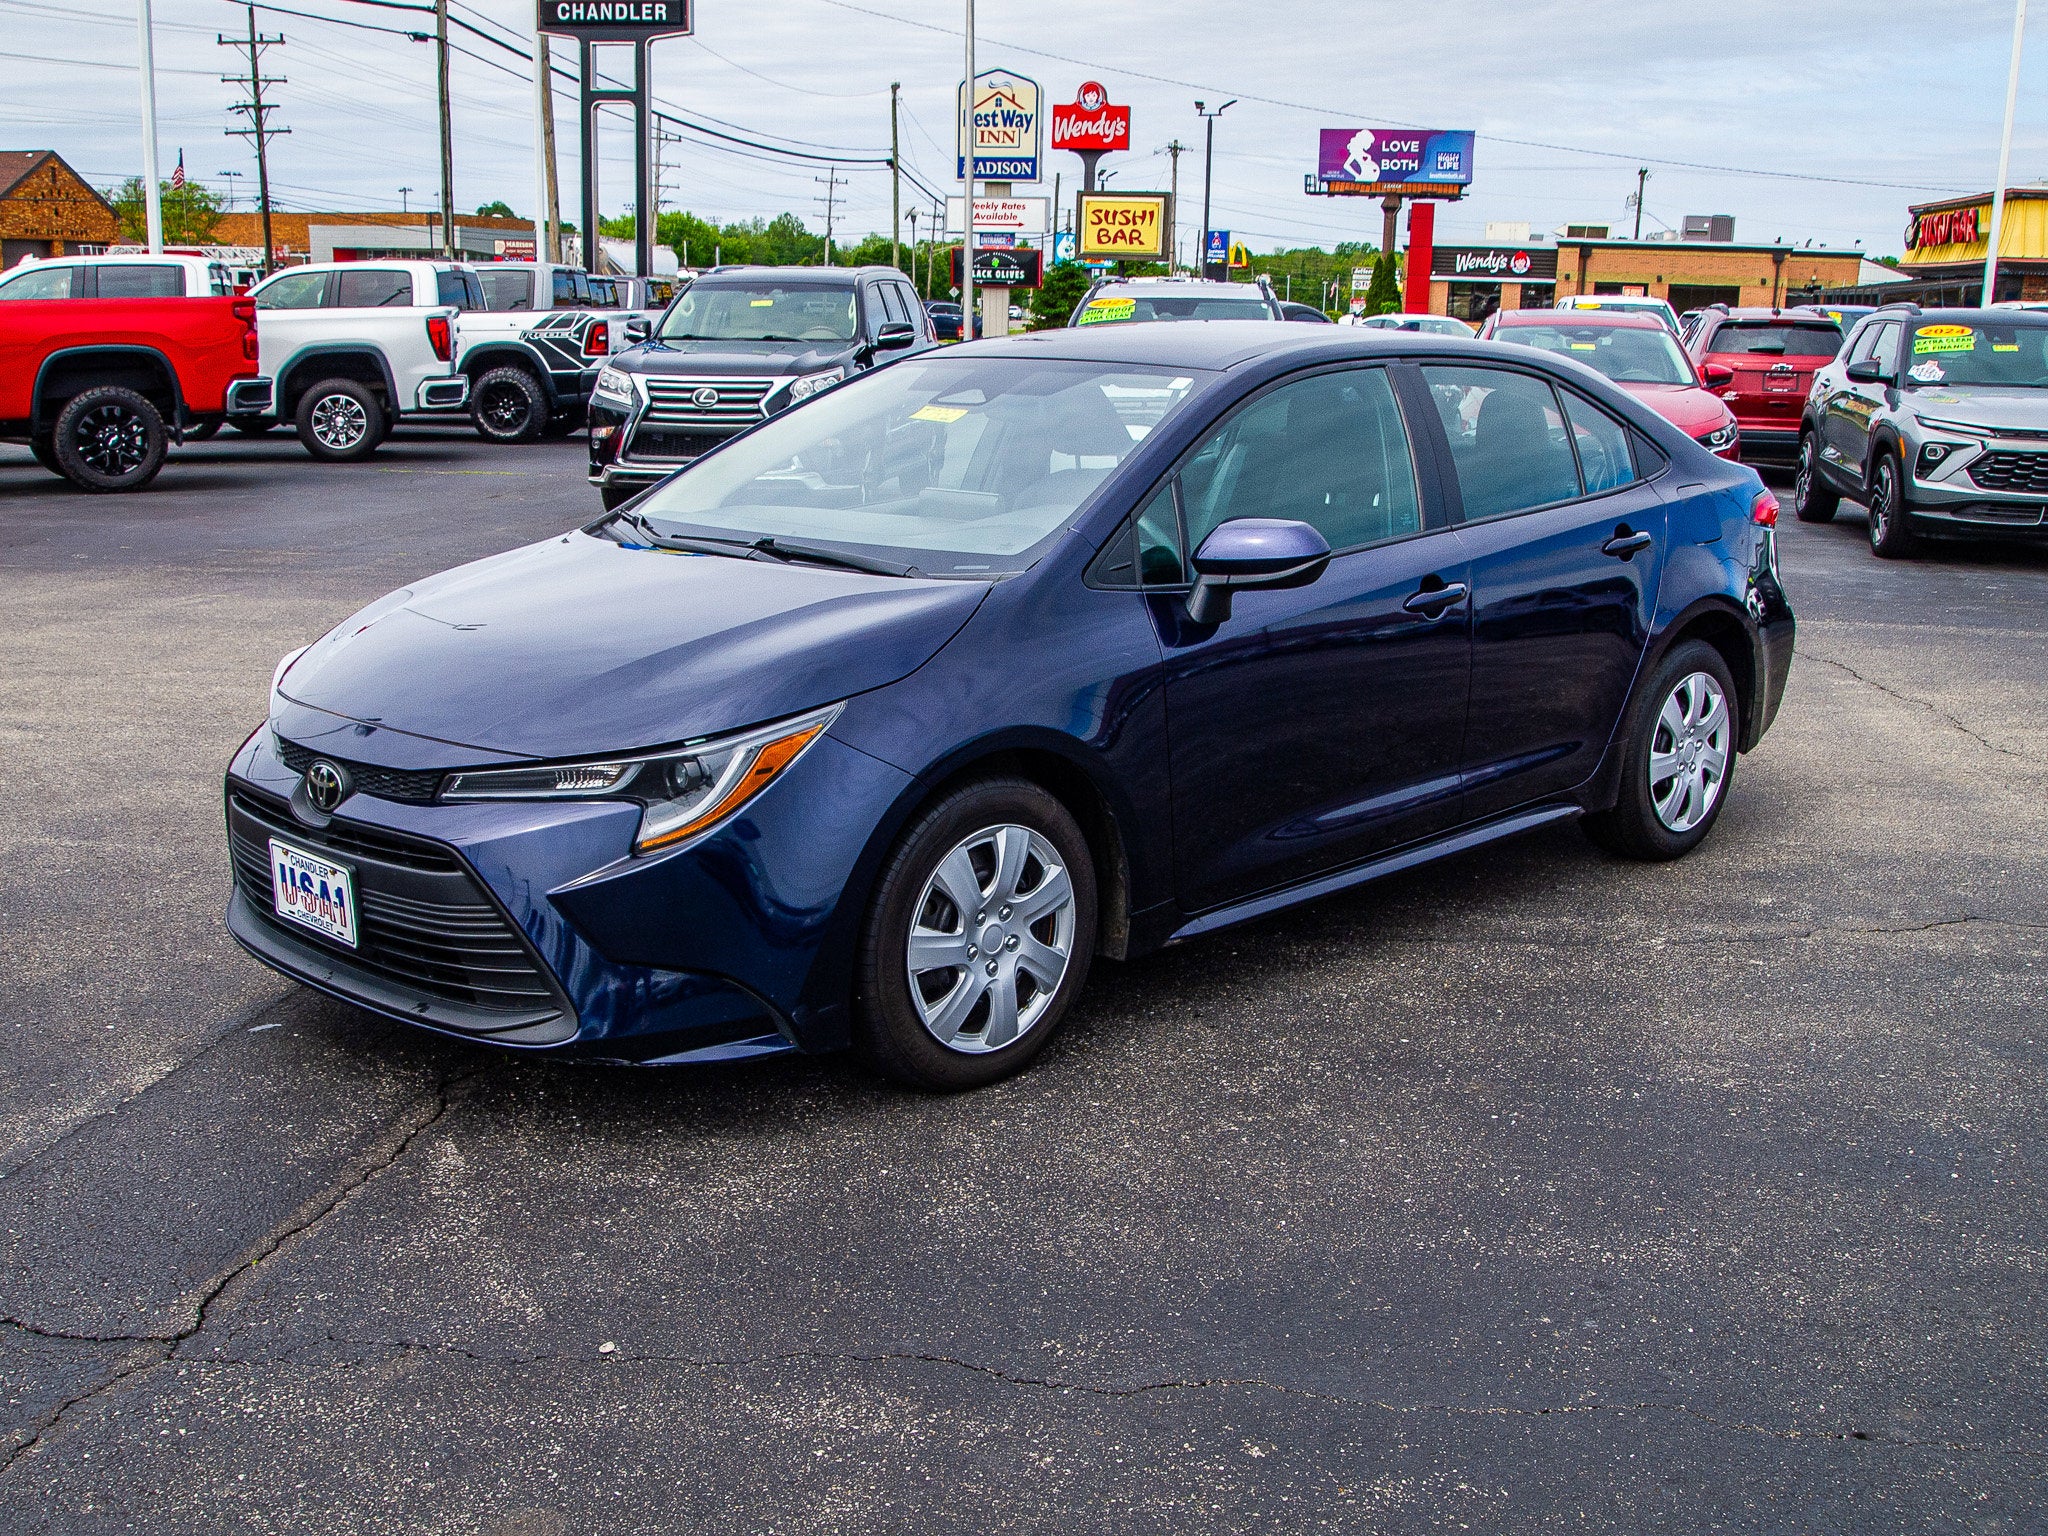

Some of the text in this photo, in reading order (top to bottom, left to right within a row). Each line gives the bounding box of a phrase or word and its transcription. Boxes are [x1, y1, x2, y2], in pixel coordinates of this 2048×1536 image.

[557, 2, 667, 21] CHANDLER
[963, 109, 1034, 134] est Way
[1054, 111, 1126, 143] Wendy's
[979, 130, 1016, 144] INN
[1381, 140, 1420, 153] LOVE
[1380, 159, 1419, 171] BOTH
[1437, 161, 1460, 170] LIFE
[972, 202, 1026, 212] eekly Rates
[973, 212, 1018, 221] Available
[1090, 208, 1155, 226] SUSHI
[1951, 206, 1979, 244] BAR
[1096, 228, 1145, 246] BAR
[1455, 250, 1508, 274] Wendy's
[972, 269, 1026, 280] LACK OLIVES
[1108, 305, 1133, 314] ROOF
[1923, 327, 1966, 336] 2024
[1915, 336, 1973, 346] EXTRA CLEAN
[1931, 343, 1972, 351] FINANCE
[290, 854, 330, 880] CHANDLER
[297, 909, 334, 932] CHEVROLET
